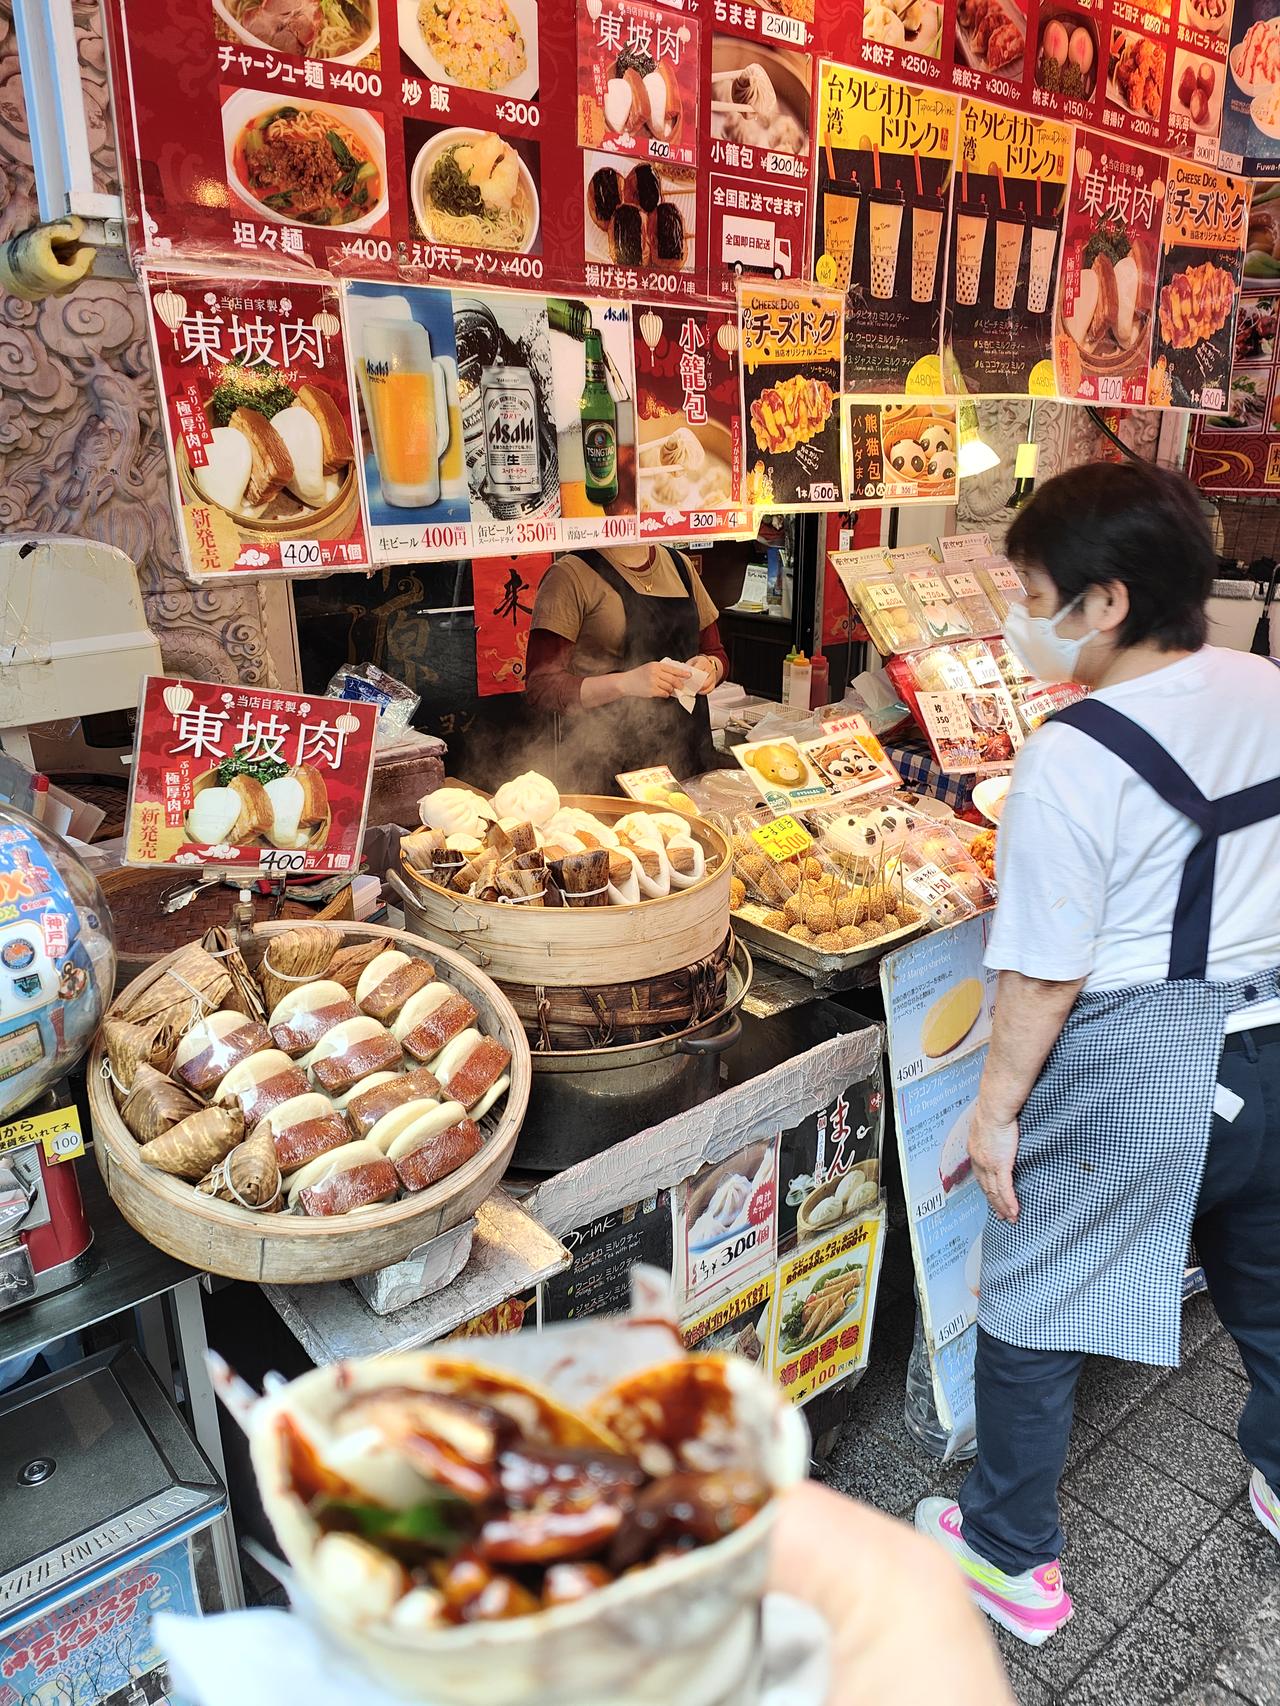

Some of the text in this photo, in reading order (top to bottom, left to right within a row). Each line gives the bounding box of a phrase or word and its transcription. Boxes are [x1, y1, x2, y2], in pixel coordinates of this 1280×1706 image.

[714, 0, 757, 30] ちまき
[766, 15, 800, 41] 250円
[597, 11, 681, 65] 東坡肉
[217, 45, 383, 97] チャーシュー麺 ¥400
[861, 43, 941, 79] 水餃子 ¥250/3ケ
[952, 67, 982, 92] 焼餃子
[847, 77, 912, 119] タピオカ
[1032, 88, 1059, 110] 桃まん
[495, 101, 540, 127] ¥300
[1102, 108, 1126, 129] 唐揚げ
[881, 116, 939, 152] ドリンク
[980, 109, 1033, 147] タピオカ
[1166, 130, 1189, 146] アイス
[711, 141, 753, 169] 小籠包
[1007, 144, 1056, 178] ドリンク
[713, 186, 803, 217] 全国配送できます
[1079, 169, 1156, 229] 東坡肉
[1173, 188, 1246, 230] チーズドッグ
[341, 239, 392, 263] ¥400
[725, 233, 771, 251] 全国即日配送
[411, 244, 544, 280] えび天ラーメン ¥400
[585, 264, 695, 295] 揚げもち ¥200/1串
[220, 297, 279, 312] 当店自家製
[604, 306, 629, 322] Asahi
[751, 297, 800, 310] CHEESE DOG
[177, 311, 326, 369] 東坡肉
[752, 310, 839, 348] チーズドッグ
[774, 348, 833, 358] 当店オリジナルメニュー
[366, 358, 389, 377] Asahi
[680, 317, 707, 425] 小籠包
[489, 417, 534, 444] Asahi
[853, 415, 864, 496] パンダまん
[864, 413, 881, 480] 熊猫包
[507, 454, 520, 466] 生
[191, 507, 221, 570] 新発売
[379, 526, 467, 551] 生ビール 400円
[478, 525, 515, 538] 缶ビール
[478, 536, 514, 545] スーパードライ
[516, 522, 557, 543] 350円
[601, 518, 637, 538] 400円
[284, 544, 363, 564] 400円/1個
[236, 695, 297, 713] 当店自家製
[169, 705, 347, 769] 東坡肉
[179, 761, 192, 806] ぷりっぷりの
[138, 807, 160, 860] 新発売
[775, 832, 808, 854] 500
[260, 850, 351, 871] 400円/1個
[930, 879, 951, 895] 150
[46, 916, 63, 943] 神戸
[896, 1058, 925, 1082] 450円
[0, 1120, 34, 1141] から
[54, 1135, 79, 1151] 100
[755, 1190, 772, 1207] 肉汁
[915, 1192, 943, 1218] 450円
[559, 1215, 617, 1252] Drink
[574, 1248, 603, 1268] タピオカ
[575, 1272, 603, 1291] ウーロン
[575, 1289, 612, 1314] ジャスミン
[938, 1314, 965, 1343] 450円
[779, 1325, 860, 1386] 海鮮春巻
[93, 1494, 194, 1549] BEAVER
[2, 1572, 161, 1678] 神戸クリスタル
[35, 1598, 138, 1677] ストラップ
